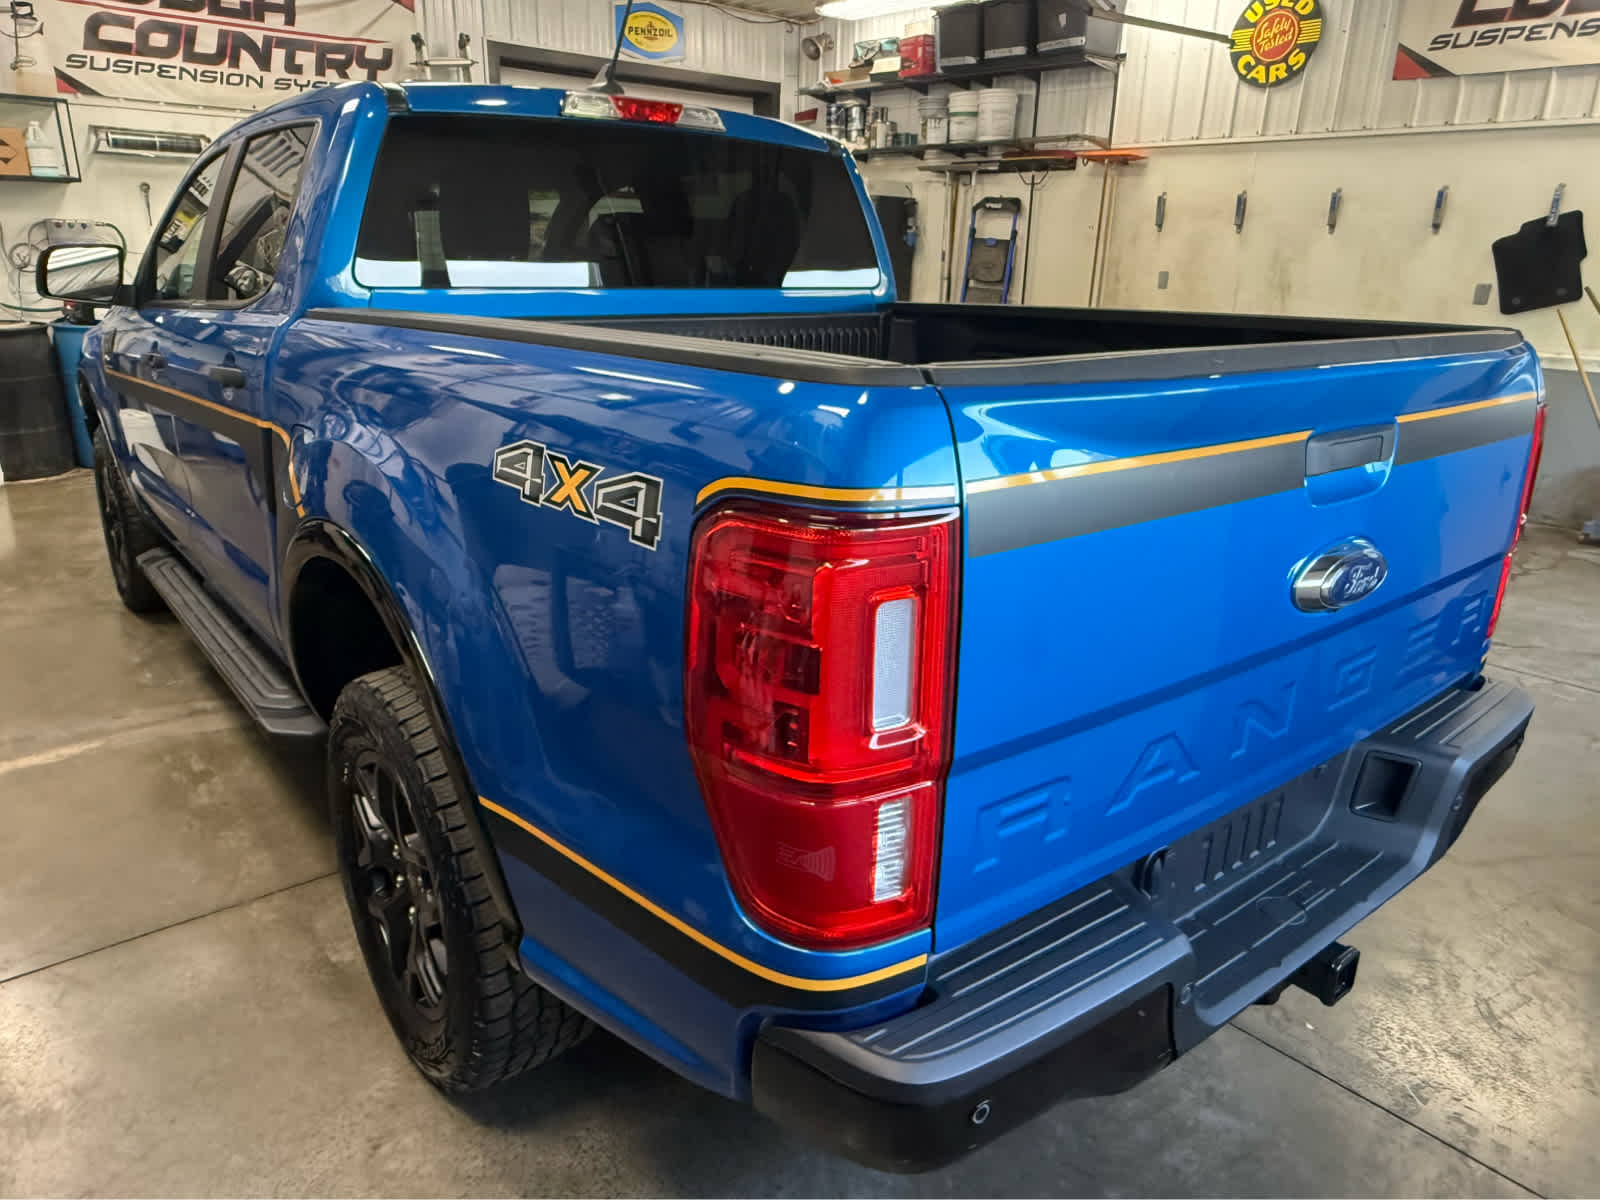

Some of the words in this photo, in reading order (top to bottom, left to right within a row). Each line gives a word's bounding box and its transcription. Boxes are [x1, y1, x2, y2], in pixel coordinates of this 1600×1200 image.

[83, 11, 393, 81] COUNTRY
[627, 25, 673, 38] PENNZOIL
[65, 53, 264, 90] SUSPENSION
[1237, 48, 1306, 83] CARS
[1343, 562, 1380, 598] Ford
[972, 589, 1489, 875] RANGER
